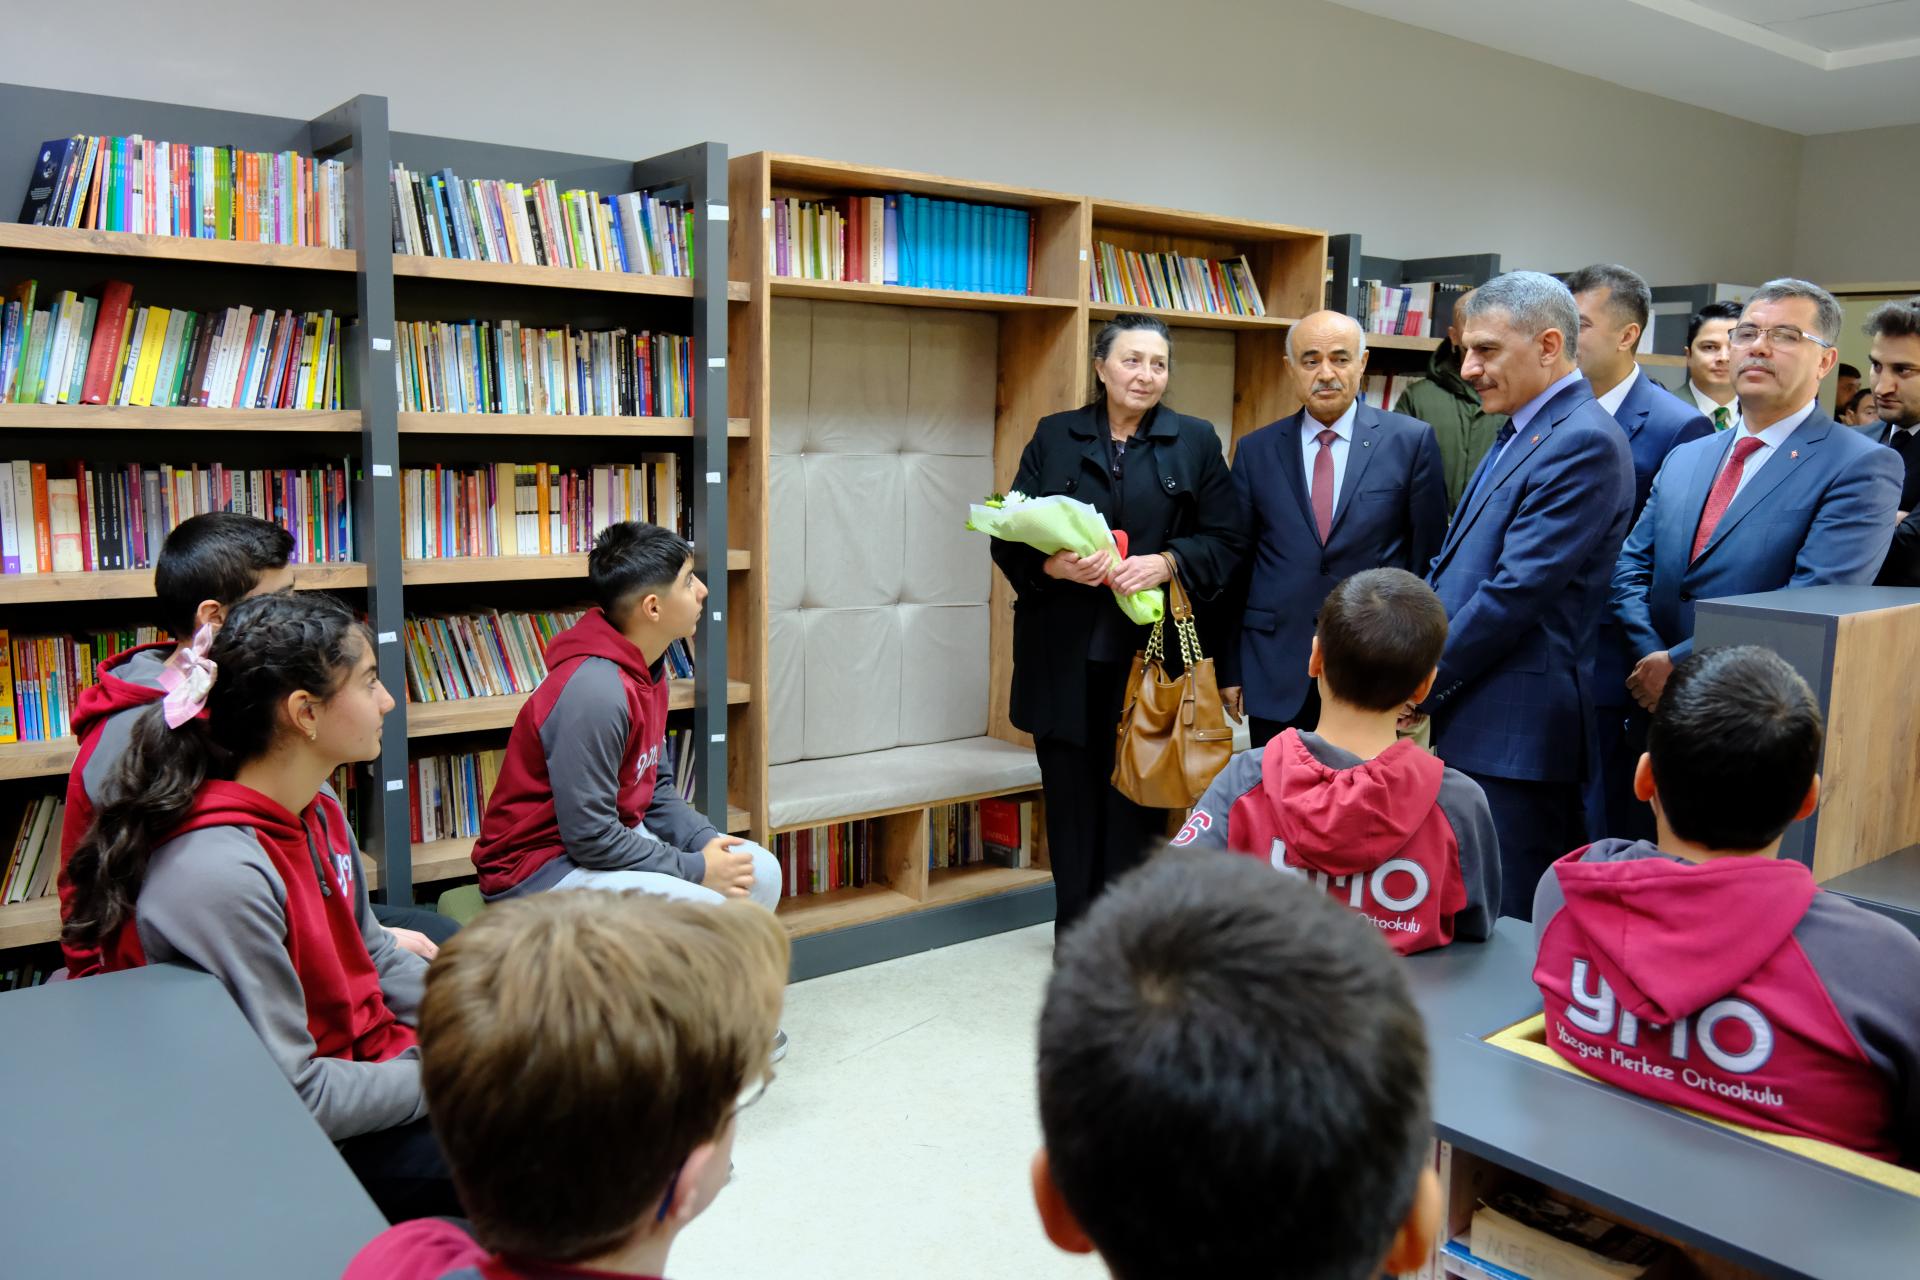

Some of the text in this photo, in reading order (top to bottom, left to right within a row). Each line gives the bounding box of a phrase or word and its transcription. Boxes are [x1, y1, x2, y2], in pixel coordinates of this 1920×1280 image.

[1556, 1021, 1784, 1106] Yozgat Merkez Ortaokulu
